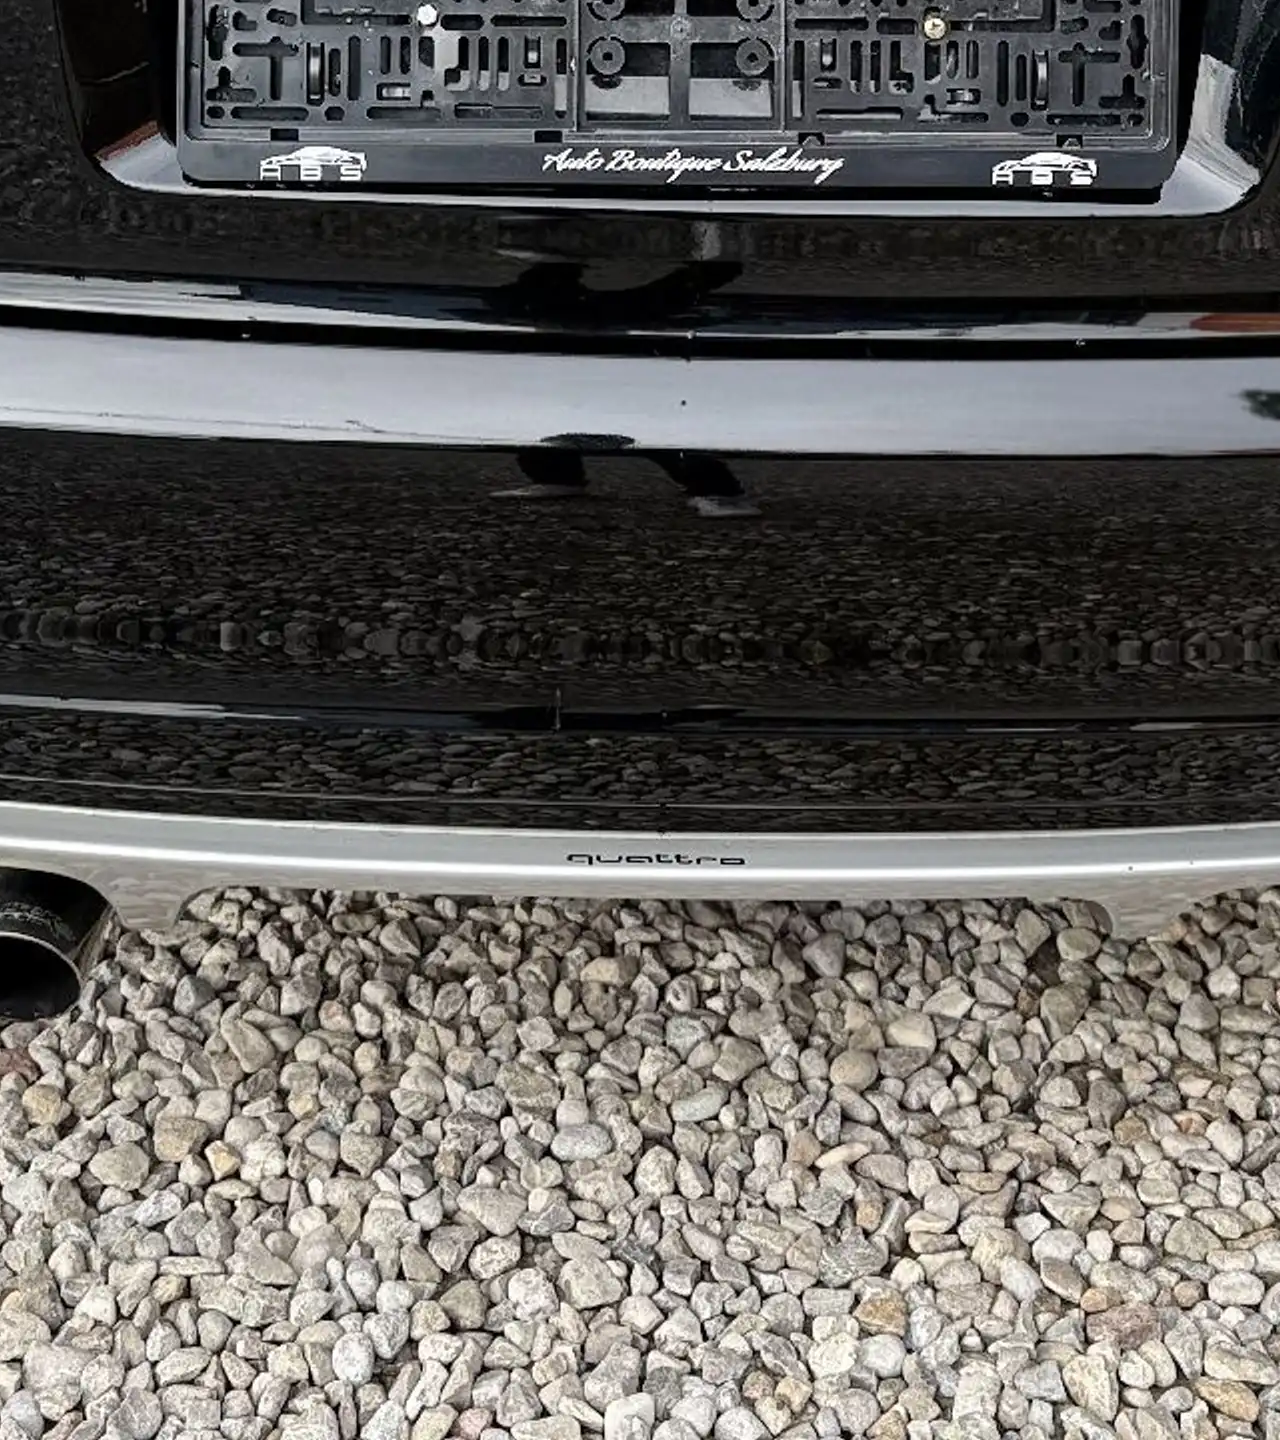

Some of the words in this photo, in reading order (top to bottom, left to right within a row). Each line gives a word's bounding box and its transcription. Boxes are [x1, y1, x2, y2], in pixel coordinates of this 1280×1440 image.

[542, 148, 604, 172] Auto
[605, 148, 723, 183] Boutique
[723, 146, 845, 185] Salzburg
[566, 853, 746, 866] quattro
